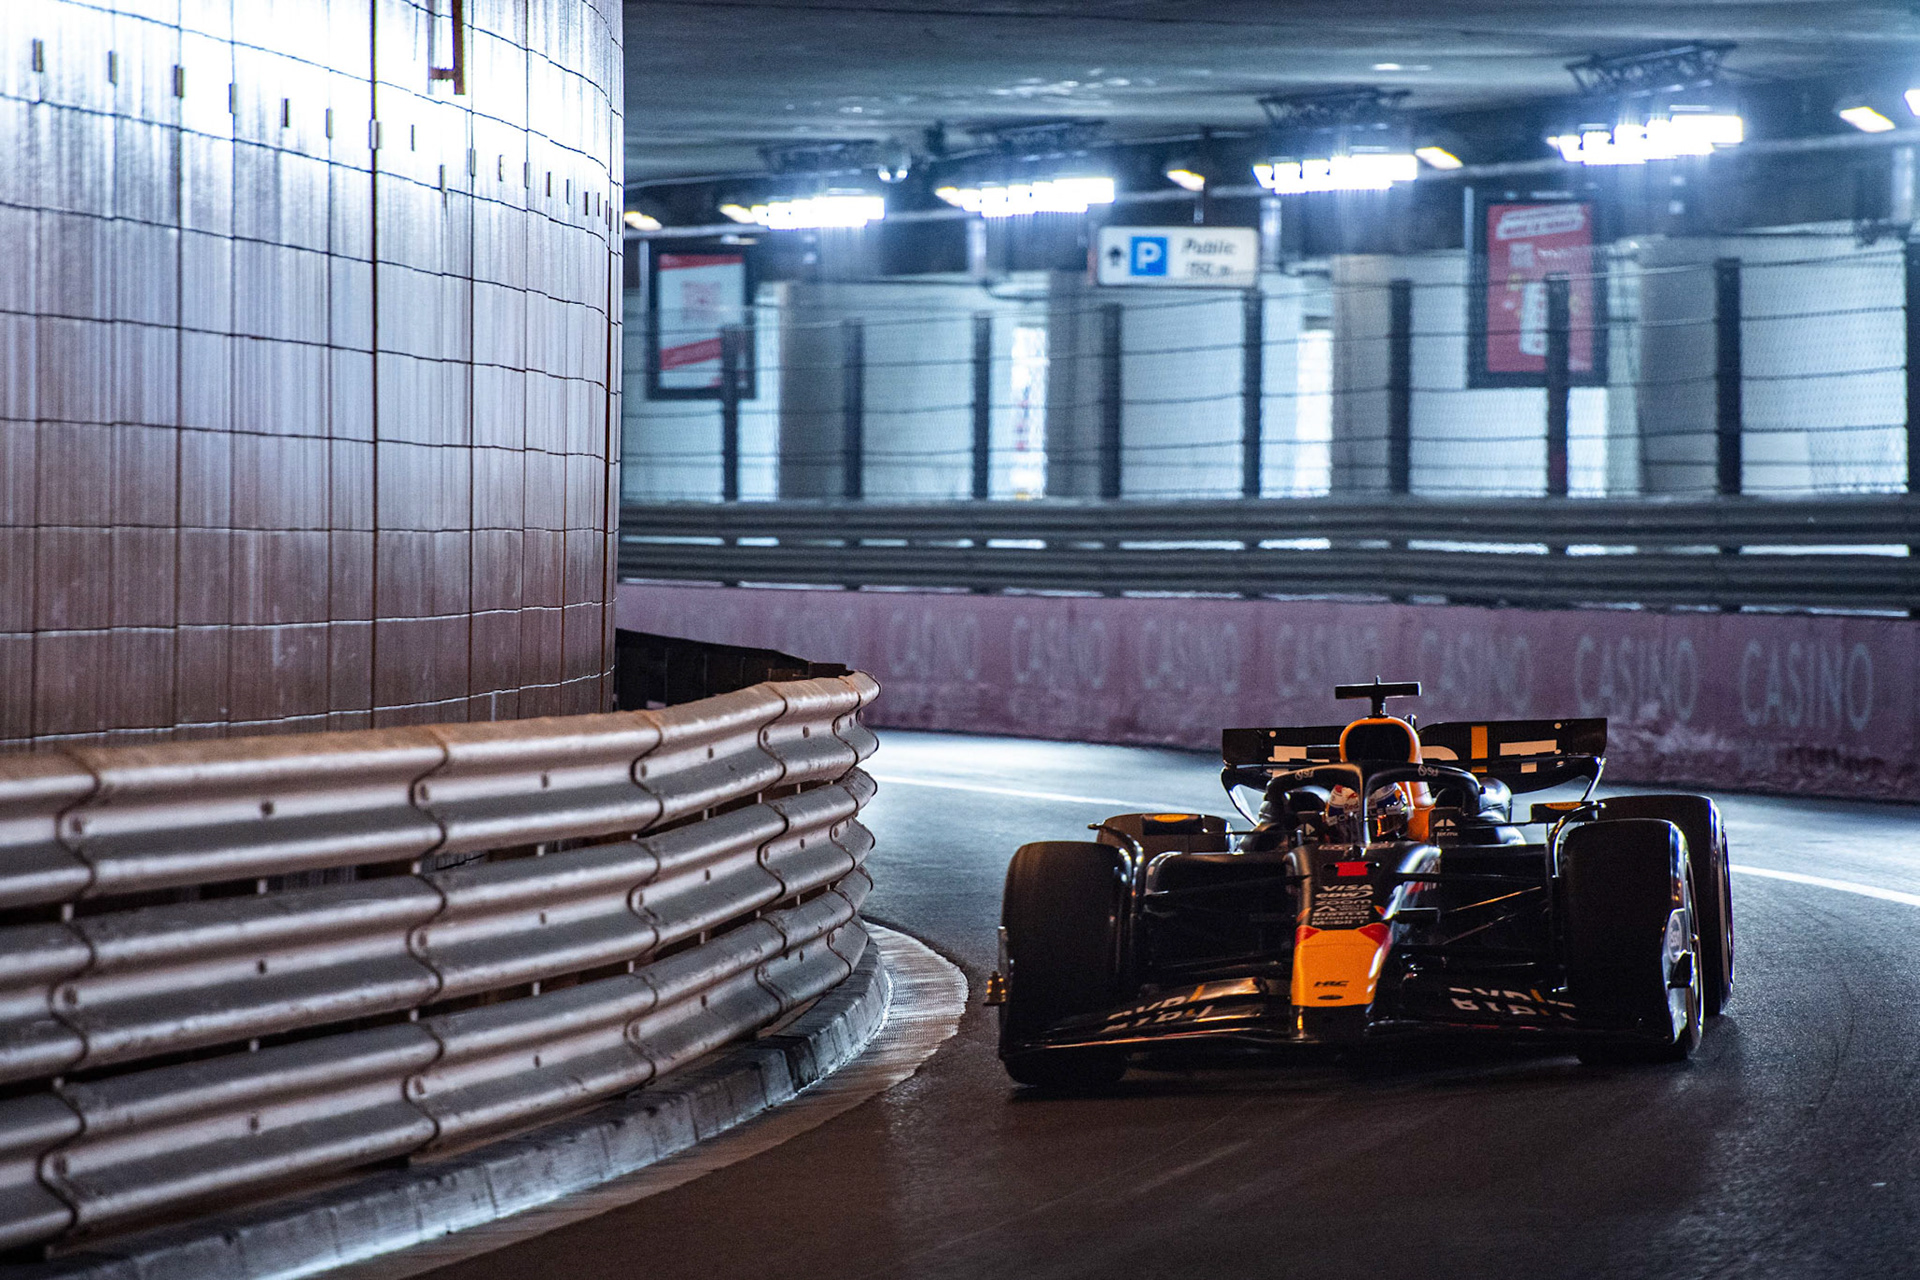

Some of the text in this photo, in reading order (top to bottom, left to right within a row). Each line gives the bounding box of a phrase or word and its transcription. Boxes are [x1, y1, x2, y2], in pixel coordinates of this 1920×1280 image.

[1137, 242, 1162, 270] P
[1575, 633, 1698, 718] CASINO
[1738, 638, 1875, 732] CASINO
[1322, 884, 1374, 892] VISA
